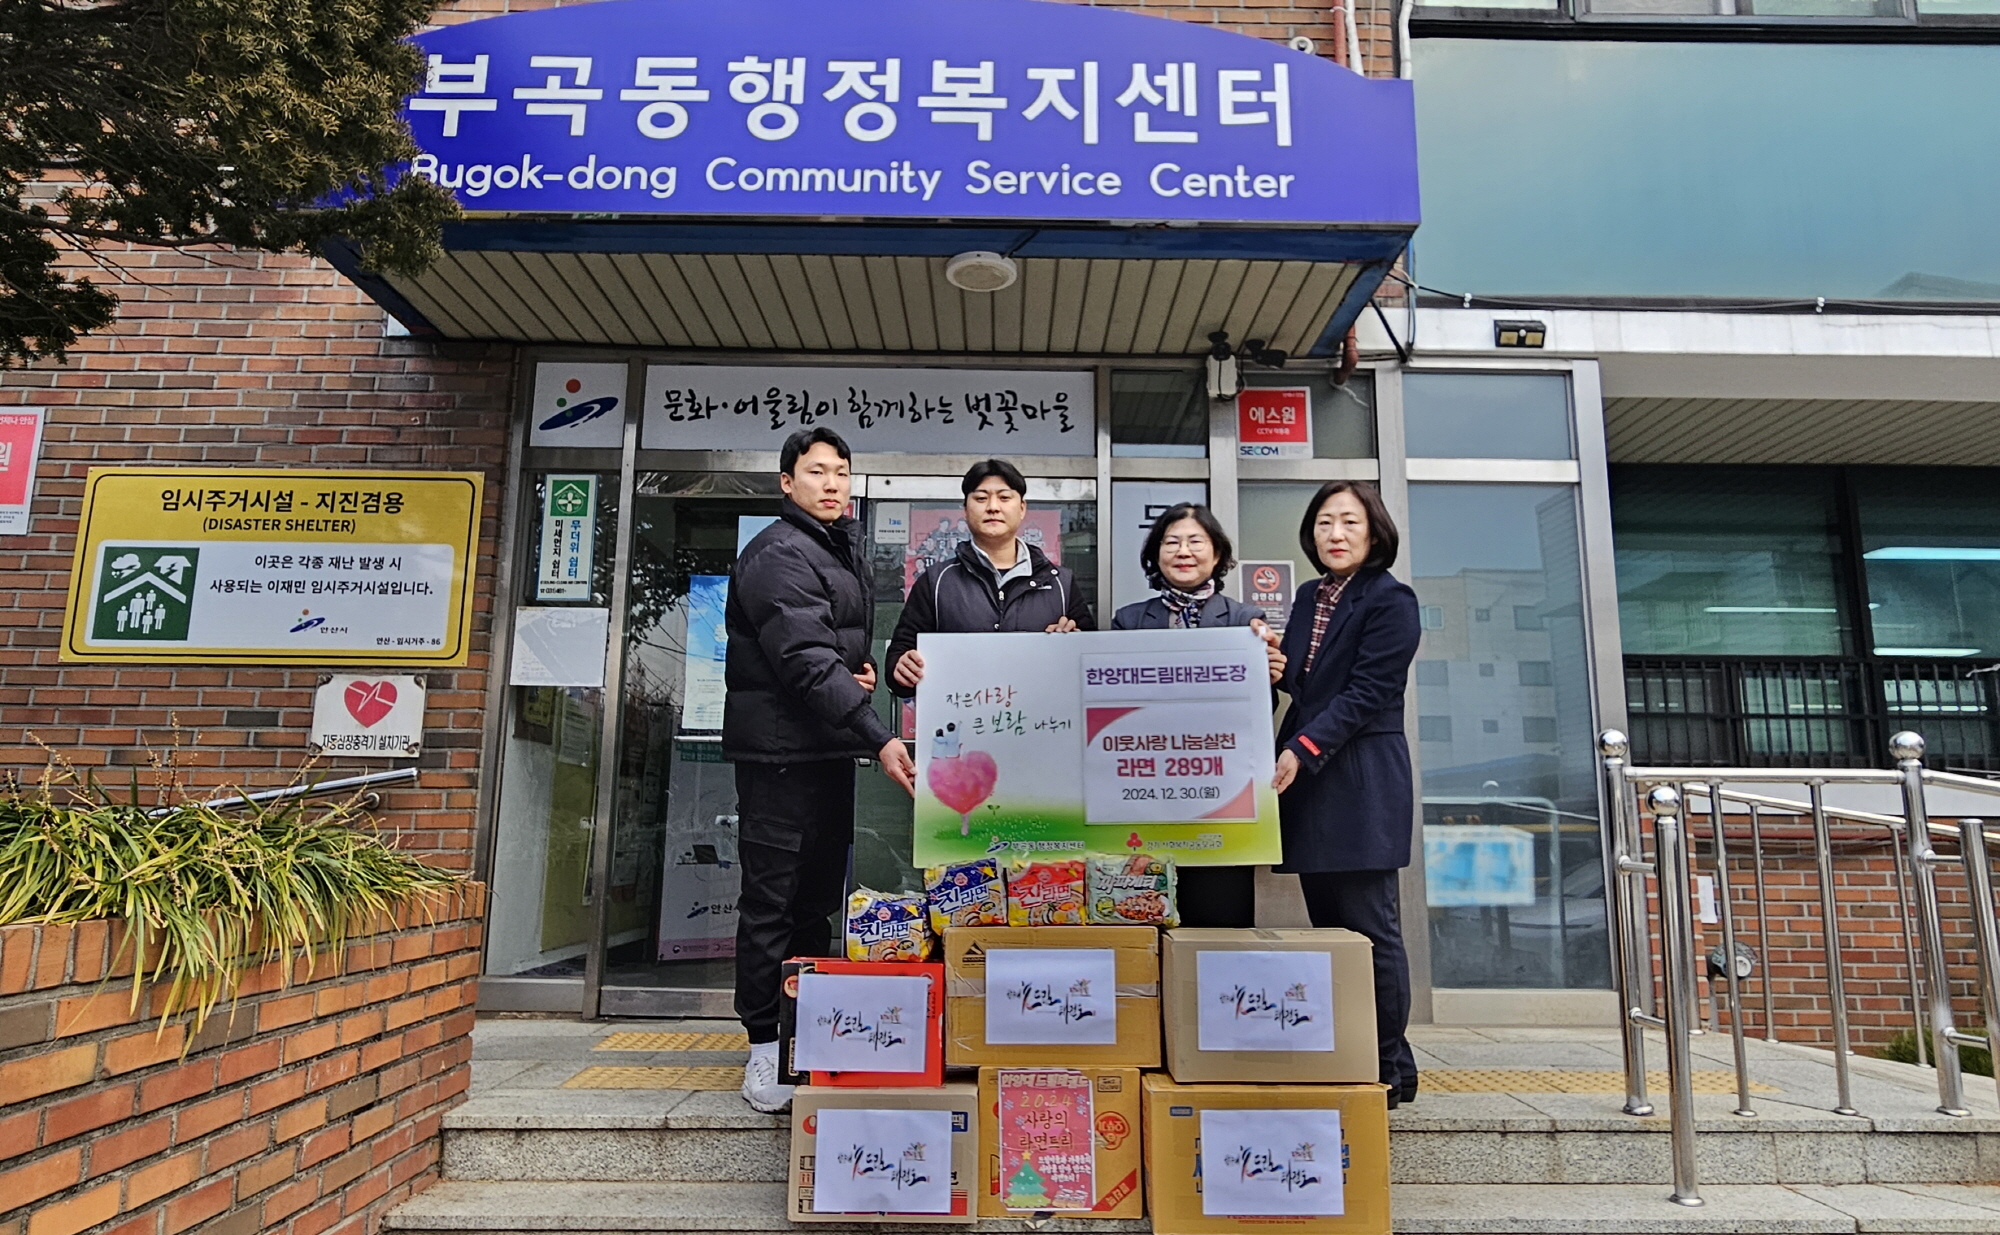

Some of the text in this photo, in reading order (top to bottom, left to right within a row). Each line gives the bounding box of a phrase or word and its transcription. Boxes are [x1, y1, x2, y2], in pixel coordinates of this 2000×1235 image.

[409, 53, 1292, 147] 부곡동행정복지센터
[412, 154, 1295, 201] Bugok-dong Community Service Center
[847, 386, 954, 429] 함께하는
[1248, 406, 1296, 424] 에스원
[1240, 445, 1279, 456] SECOM
[160, 488, 295, 513] 임시주거시설
[315, 490, 405, 514] 지진겸용
[202, 517, 356, 534] (DISASTER SHELTER)
[569, 520, 581, 553] 무더위
[254, 555, 402, 571] 이곳은 각종 재난 발생 시
[209, 579, 434, 595] 사용되는 이재민 임시주거시설입니다.
[320, 626, 348, 634] 안산시
[1085, 664, 1247, 686] 한양대드림태권도장
[972, 710, 1071, 736] 큰 보람 나누기
[322, 734, 411, 751] 자동심장충격기 설치기관
[1102, 732, 1237, 752] 이웃사랑 나눔실천
[1116, 755, 1224, 778] 라면 289개
[1096, 875, 1158, 894] 짜파게티
[936, 884, 989, 915] 진라면
[1016, 881, 1073, 910] 진라면
[859, 921, 909, 947] 진라면
[1020, 1094, 1073, 1108] 2024
[1024, 1110, 1068, 1130] 사랑의
[1019, 1131, 1073, 1151] 라면트리
